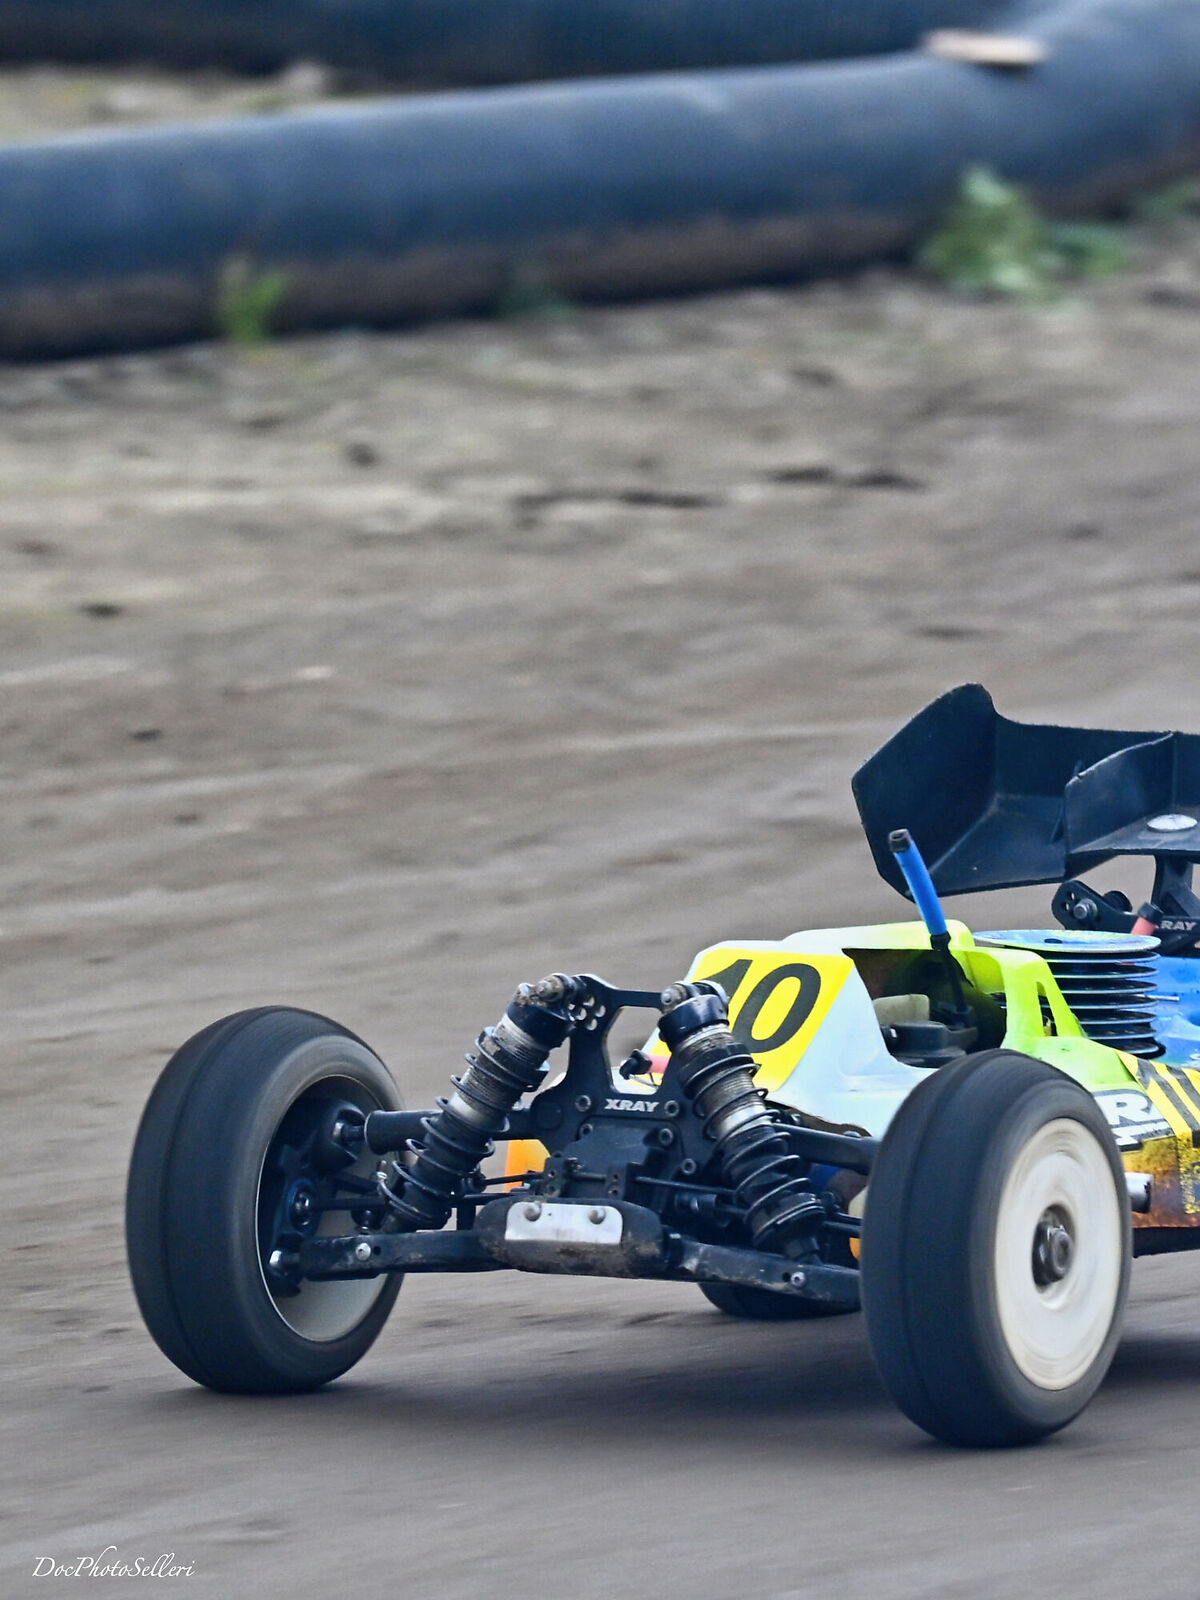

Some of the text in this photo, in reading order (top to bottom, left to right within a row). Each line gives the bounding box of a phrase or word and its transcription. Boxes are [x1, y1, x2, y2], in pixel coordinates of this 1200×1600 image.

[1155, 920, 1198, 931] RAY
[699, 959, 822, 1054] 10
[604, 1098, 660, 1112] XRAY
